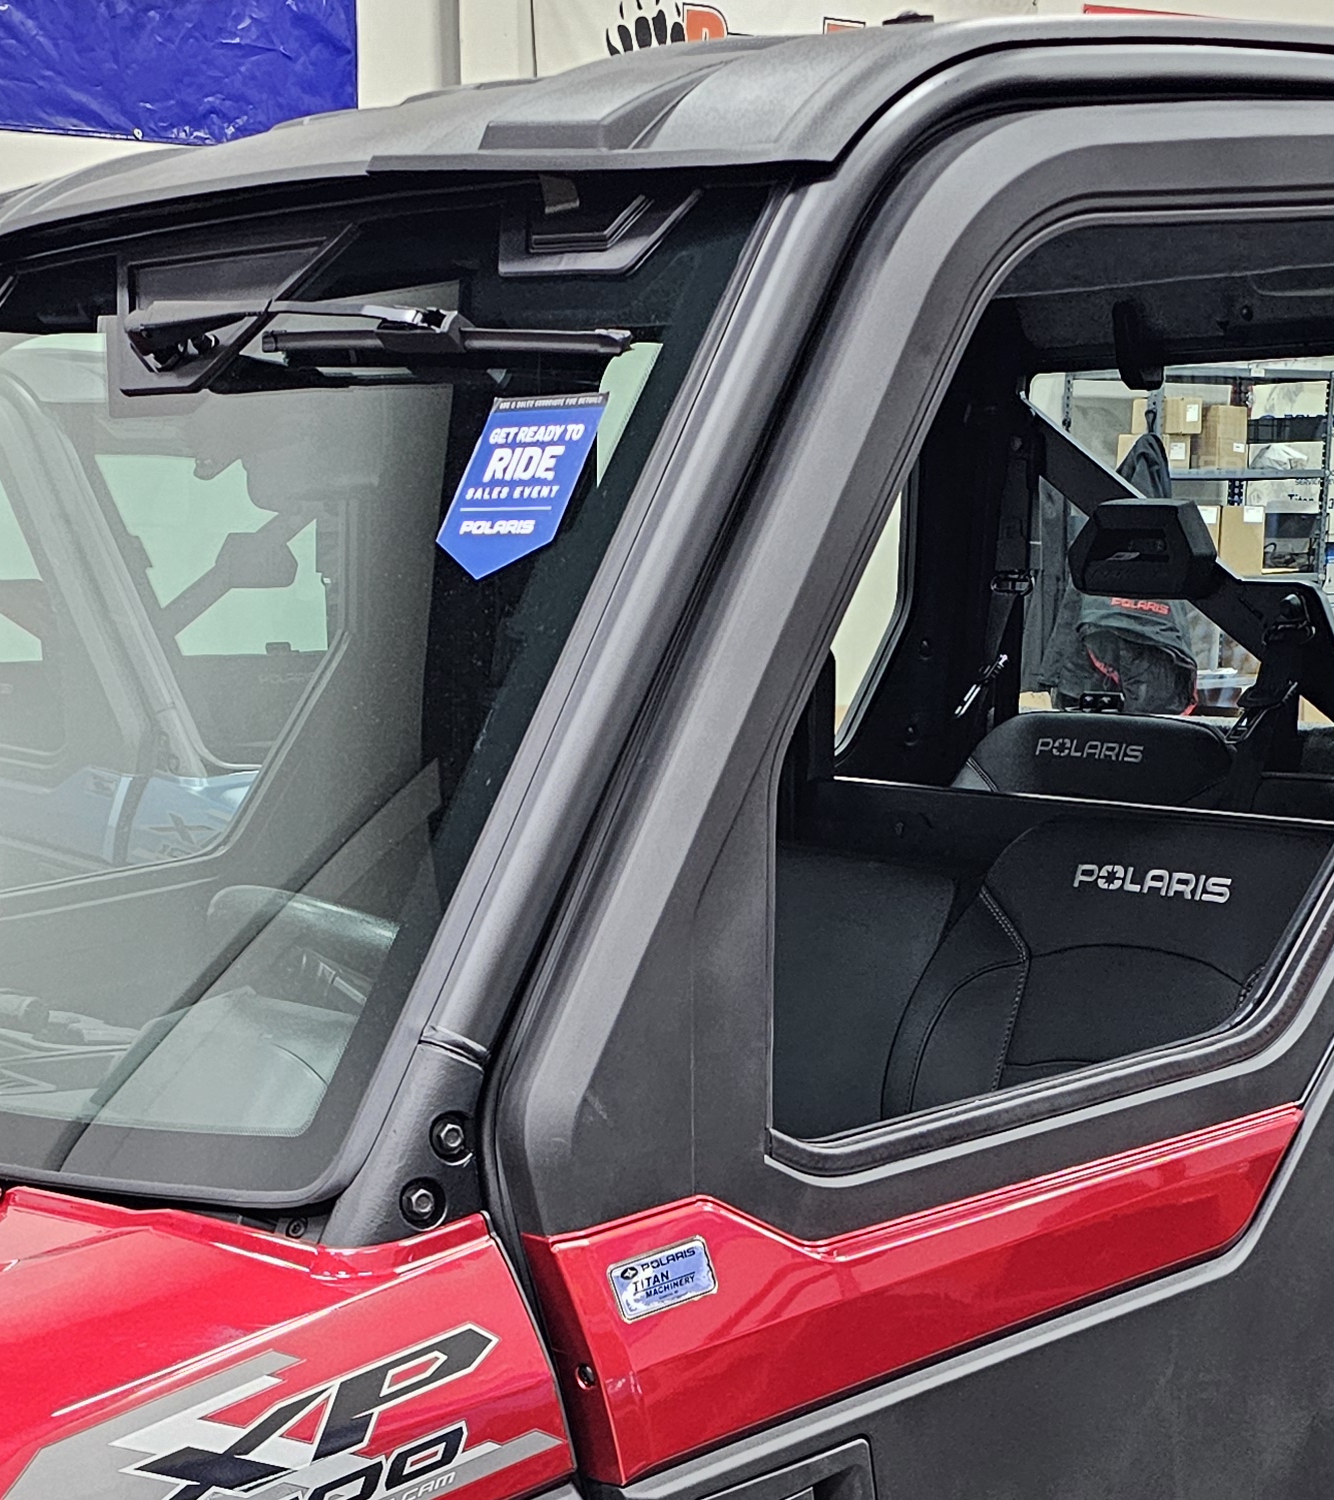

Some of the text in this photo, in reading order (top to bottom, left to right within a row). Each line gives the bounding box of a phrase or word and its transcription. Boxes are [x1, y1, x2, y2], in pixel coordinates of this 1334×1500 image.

[489, 423, 585, 444] GET READY TO
[482, 445, 565, 482] RIDE
[465, 485, 559, 500] SALES EVENT
[459, 519, 536, 535] POLARIS
[1110, 597, 1170, 615] POLARIS
[1035, 737, 1144, 763] POLARIS
[1072, 863, 1233, 904] POLARIS
[641, 1247, 696, 1272] POLARIS
[633, 1270, 670, 1296] TITAN
[645, 1274, 696, 1299] MACHINERY
